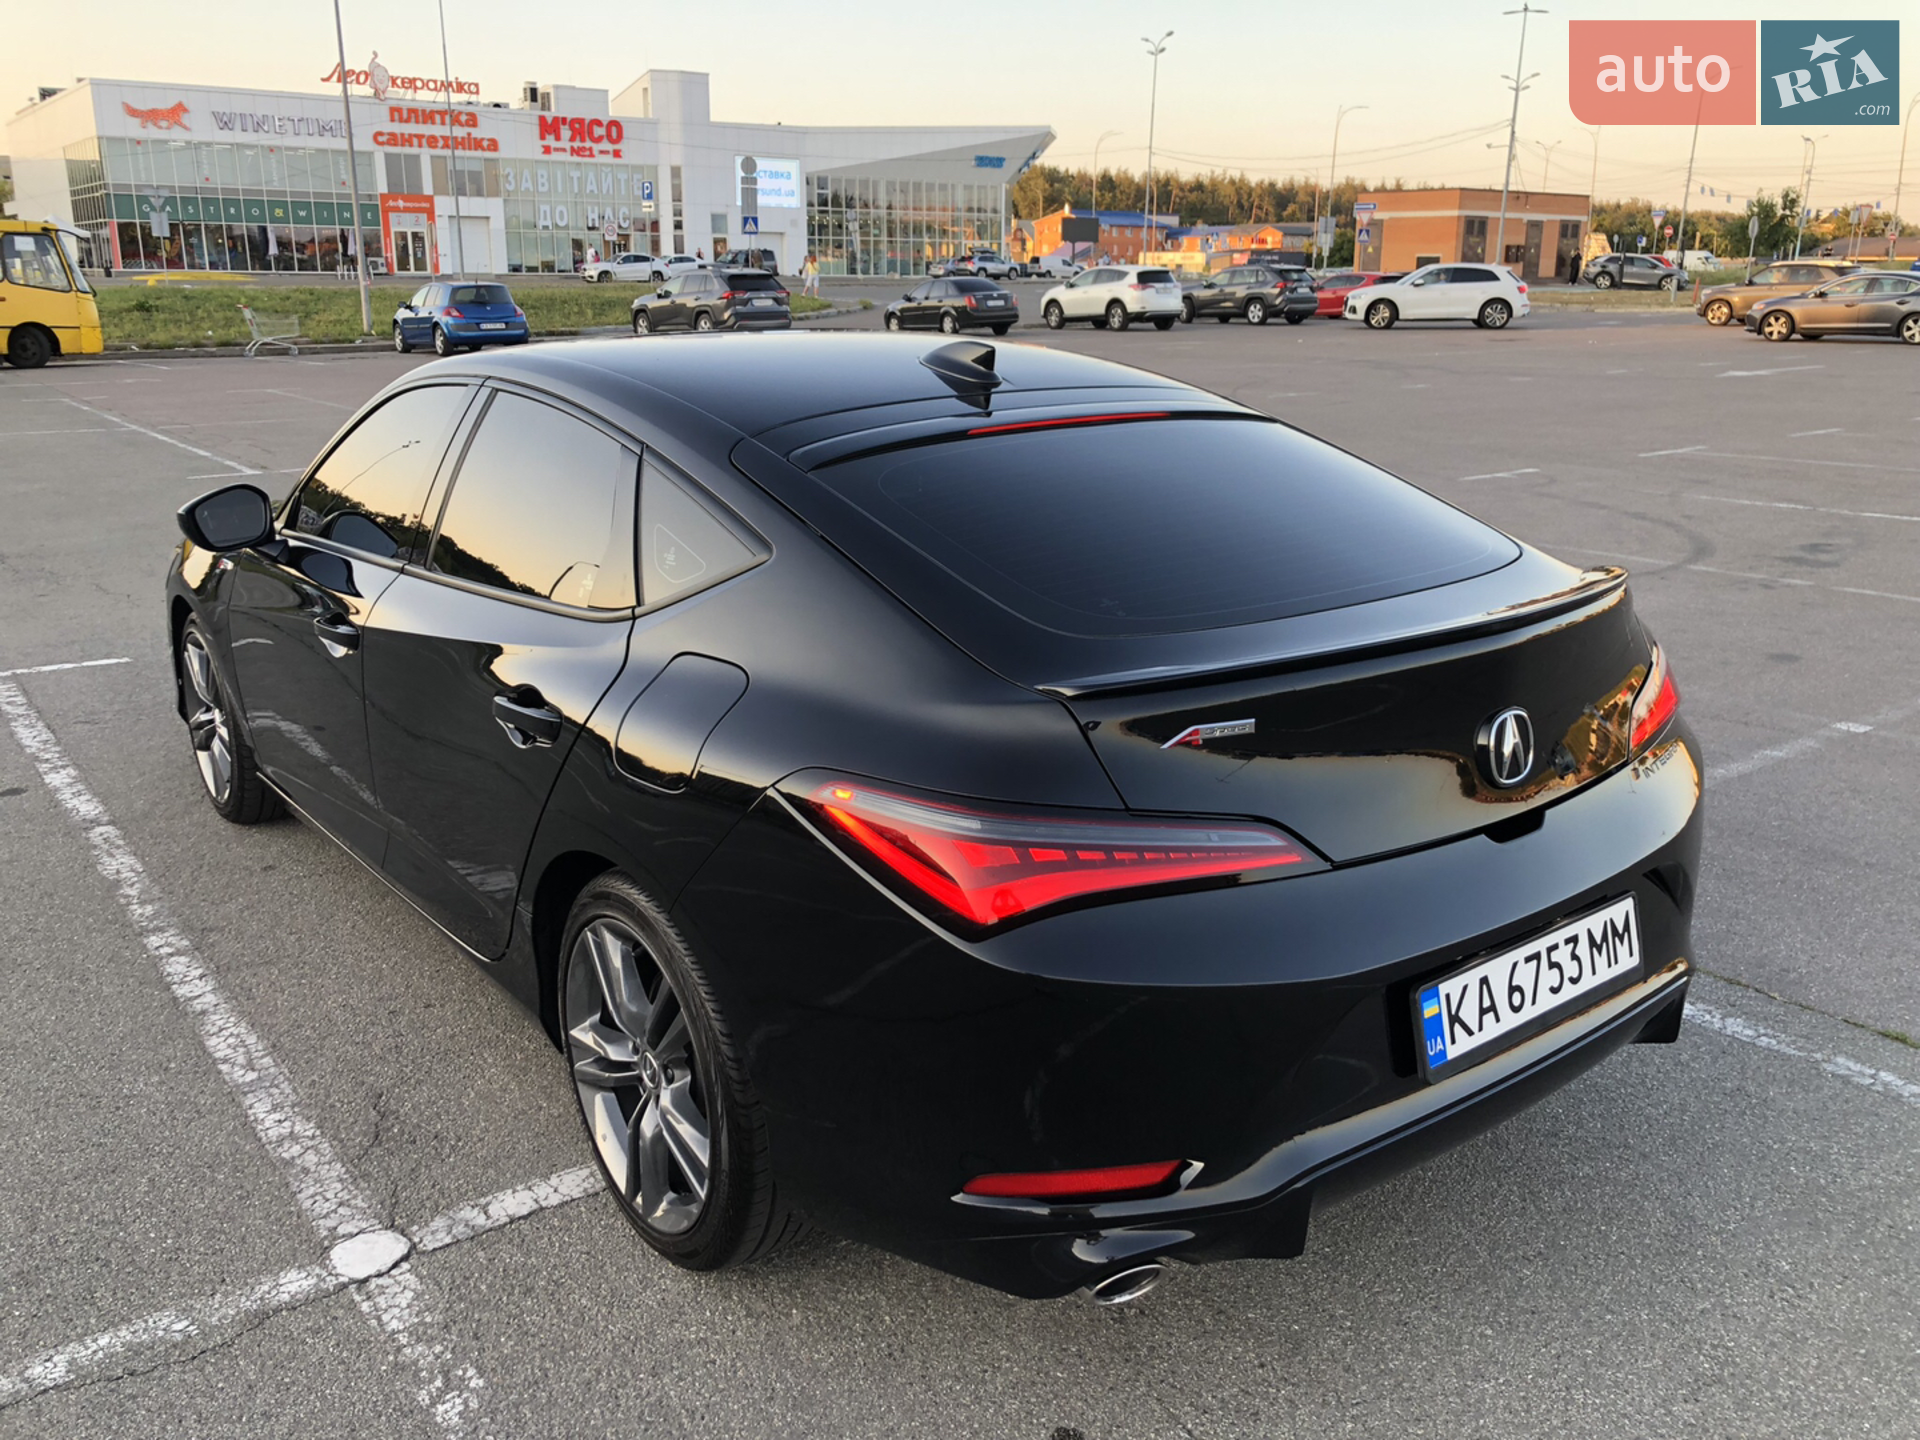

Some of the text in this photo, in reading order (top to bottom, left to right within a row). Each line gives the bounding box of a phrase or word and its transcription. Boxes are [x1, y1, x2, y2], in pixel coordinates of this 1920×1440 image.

[320, 61, 480, 95] Лео кераміка
[389, 106, 478, 128] плитка
[538, 114, 624, 145] М'ЯСО
[373, 131, 500, 153] сантехніка
[504, 166, 643, 196] ЗАВІТАЙТЕ
[142, 203, 373, 220] GASTRO & WINE
[538, 205, 630, 230] ДО НАС
[1445, 910, 1634, 1046] KA 6753 MM
[1427, 1035, 1445, 1056] UA
